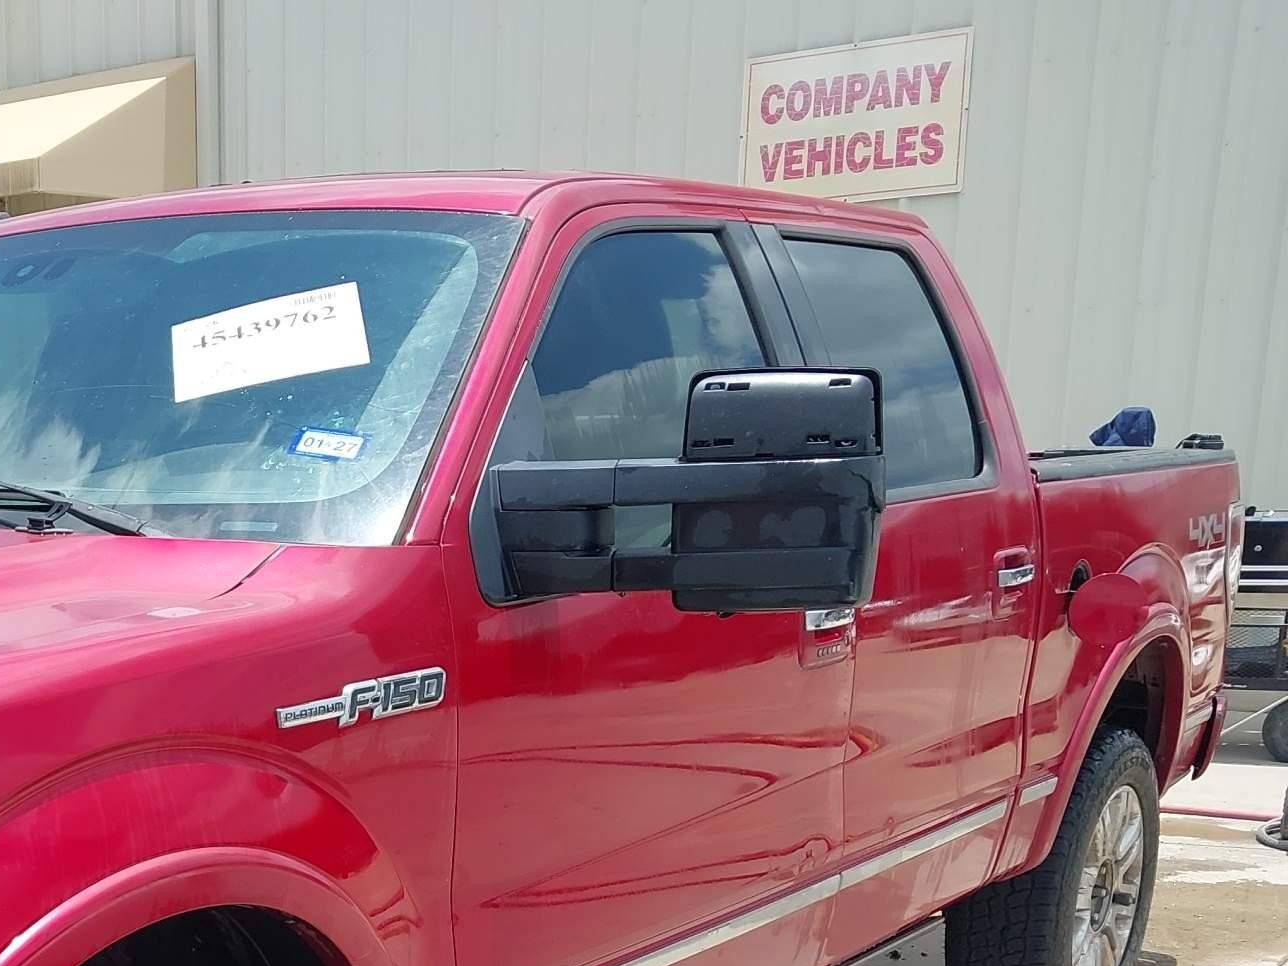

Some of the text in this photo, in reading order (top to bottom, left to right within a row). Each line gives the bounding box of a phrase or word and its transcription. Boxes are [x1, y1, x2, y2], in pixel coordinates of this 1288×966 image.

[760, 61, 952, 125] COMPANY
[760, 122, 944, 182] VEHICLES
[192, 305, 337, 348] 45439762
[284, 667, 447, 728] PLATINUM F-150
